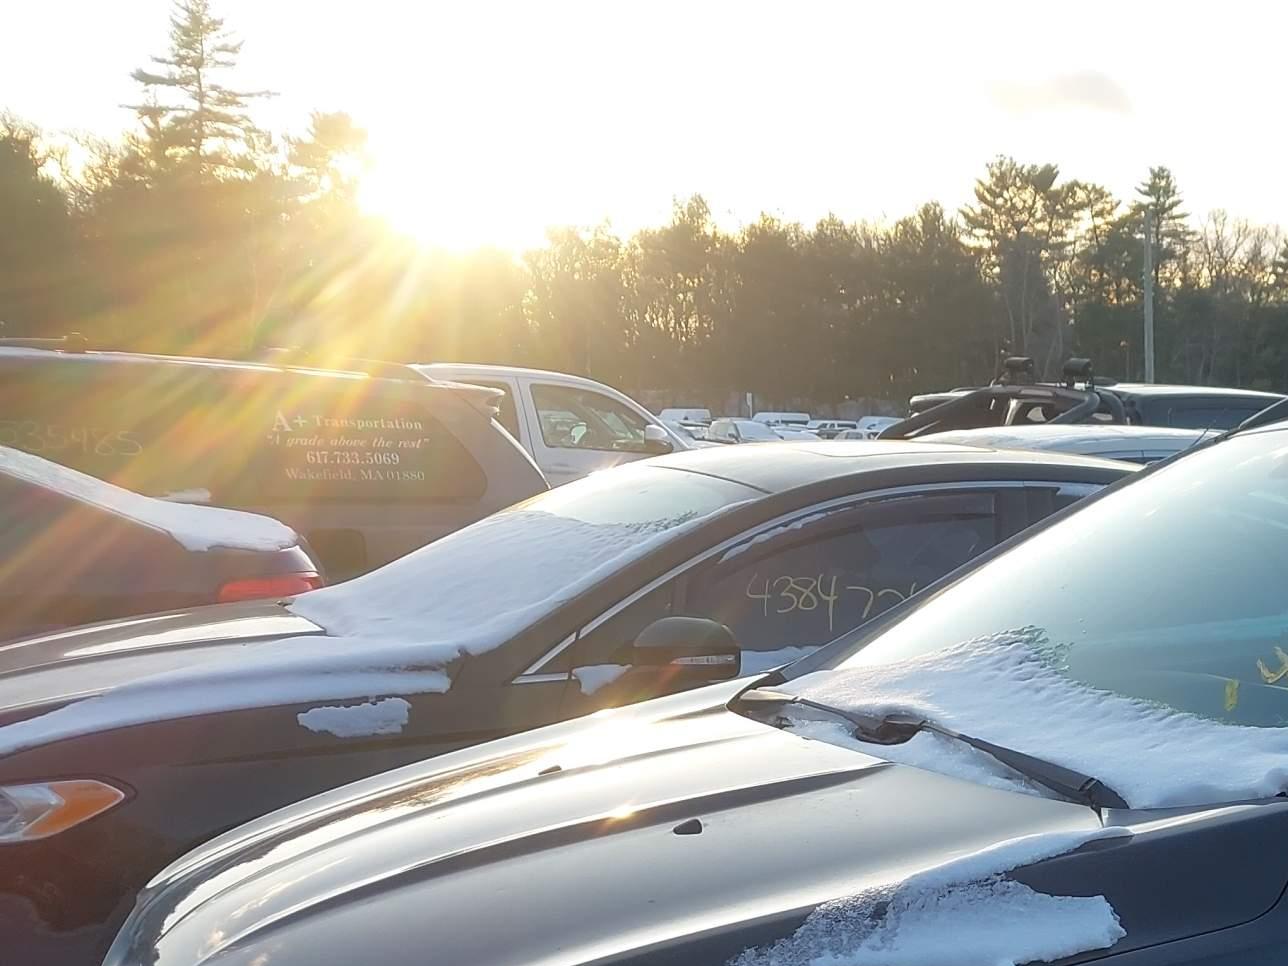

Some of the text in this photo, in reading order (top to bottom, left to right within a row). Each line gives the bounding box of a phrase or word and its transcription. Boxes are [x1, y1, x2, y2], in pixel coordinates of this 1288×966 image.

[271, 408, 423, 432] A+ Transportation
[285, 434, 323, 448] grade
[329, 435, 367, 448] above
[372, 436, 393, 448] the
[305, 450, 401, 465] 617.733.5069
[359, 468, 384, 481] MA
[386, 470, 425, 481] 01880
